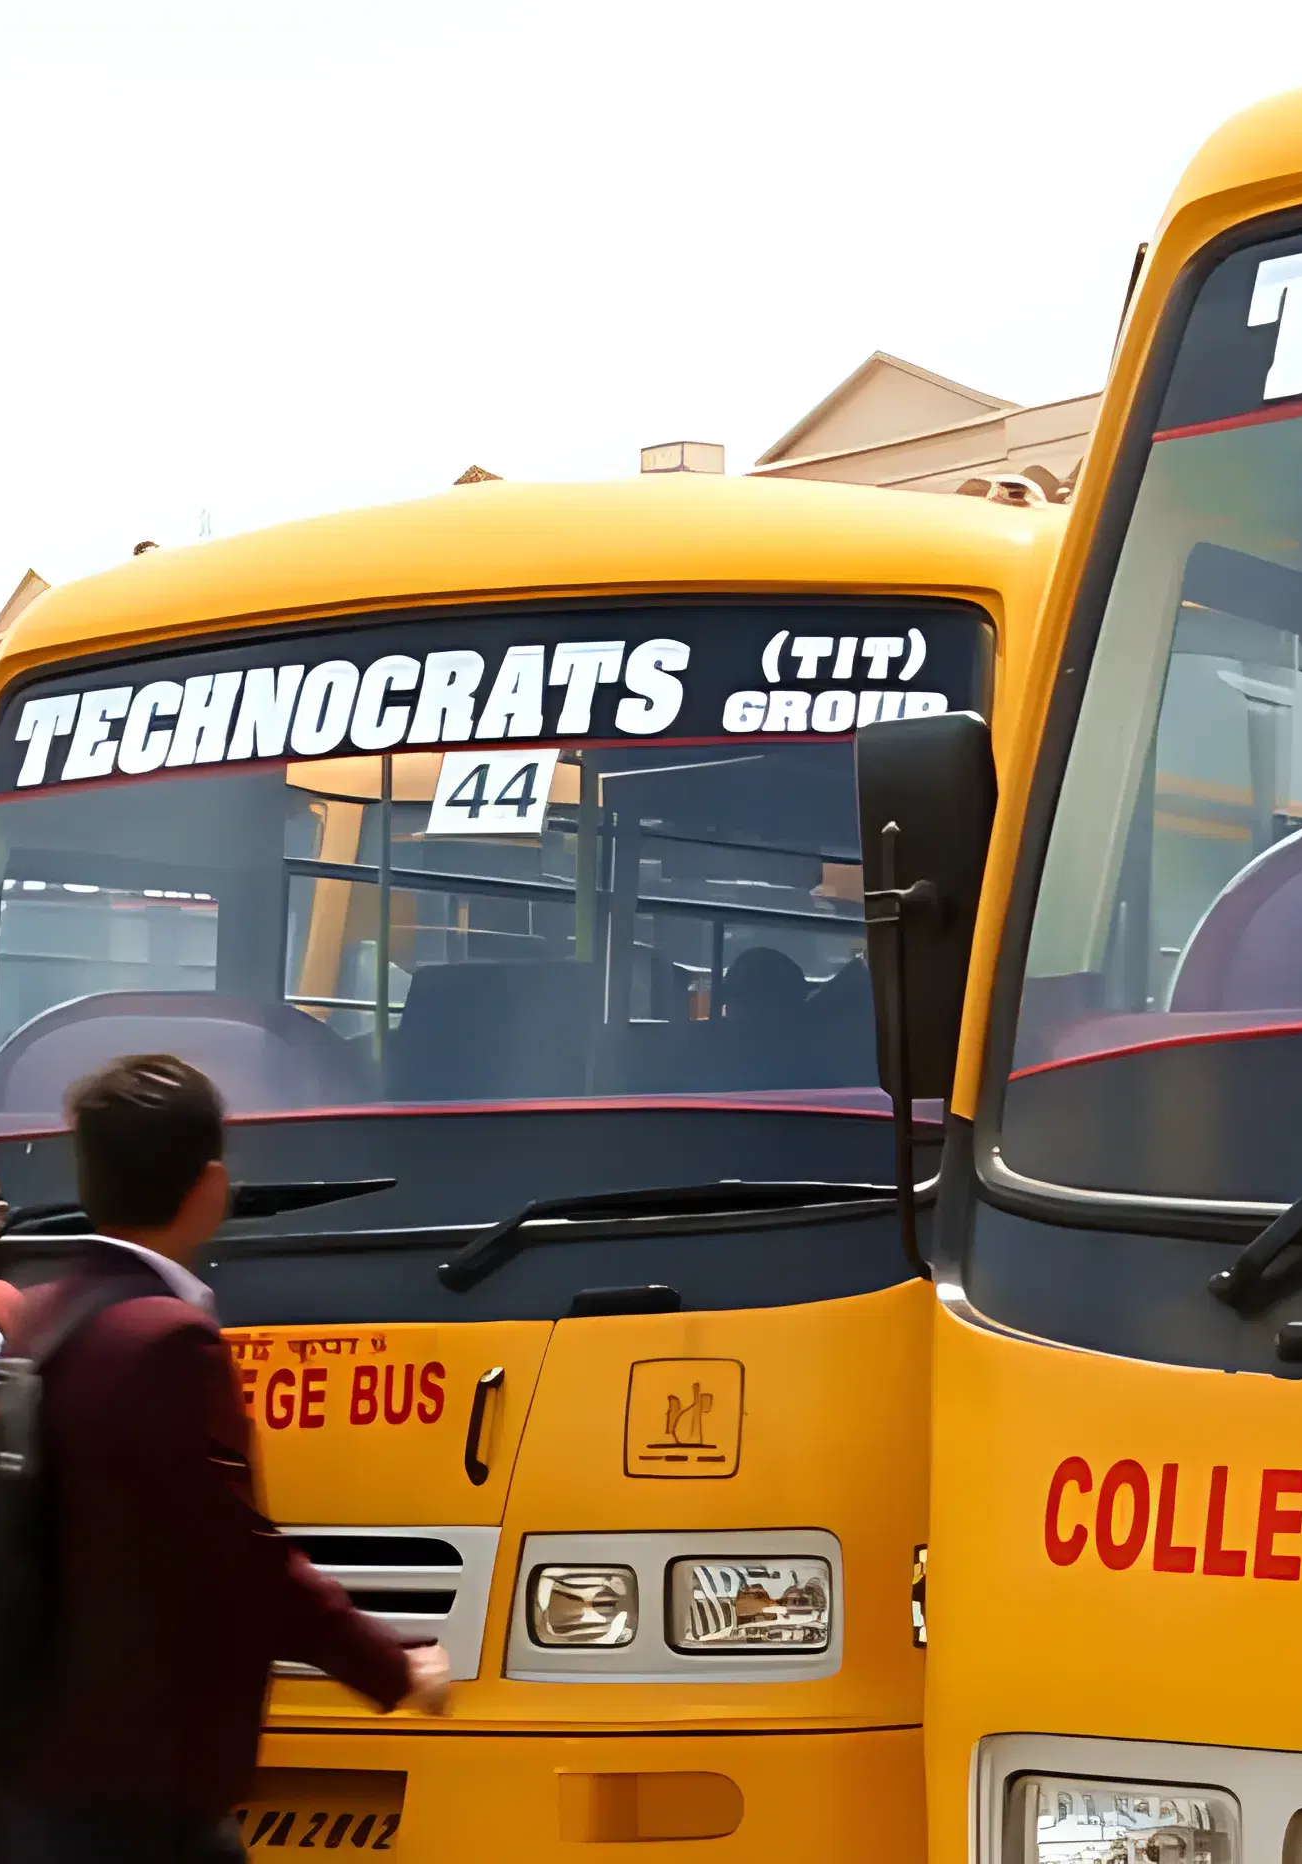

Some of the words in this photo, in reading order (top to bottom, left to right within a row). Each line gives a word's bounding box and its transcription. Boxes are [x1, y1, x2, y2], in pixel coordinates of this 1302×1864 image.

[761, 627, 927, 683] (TIT)
[15, 637, 691, 787] TECHNOCRATS
[445, 762, 538, 820] 44
[349, 1361, 446, 1425] BUS
